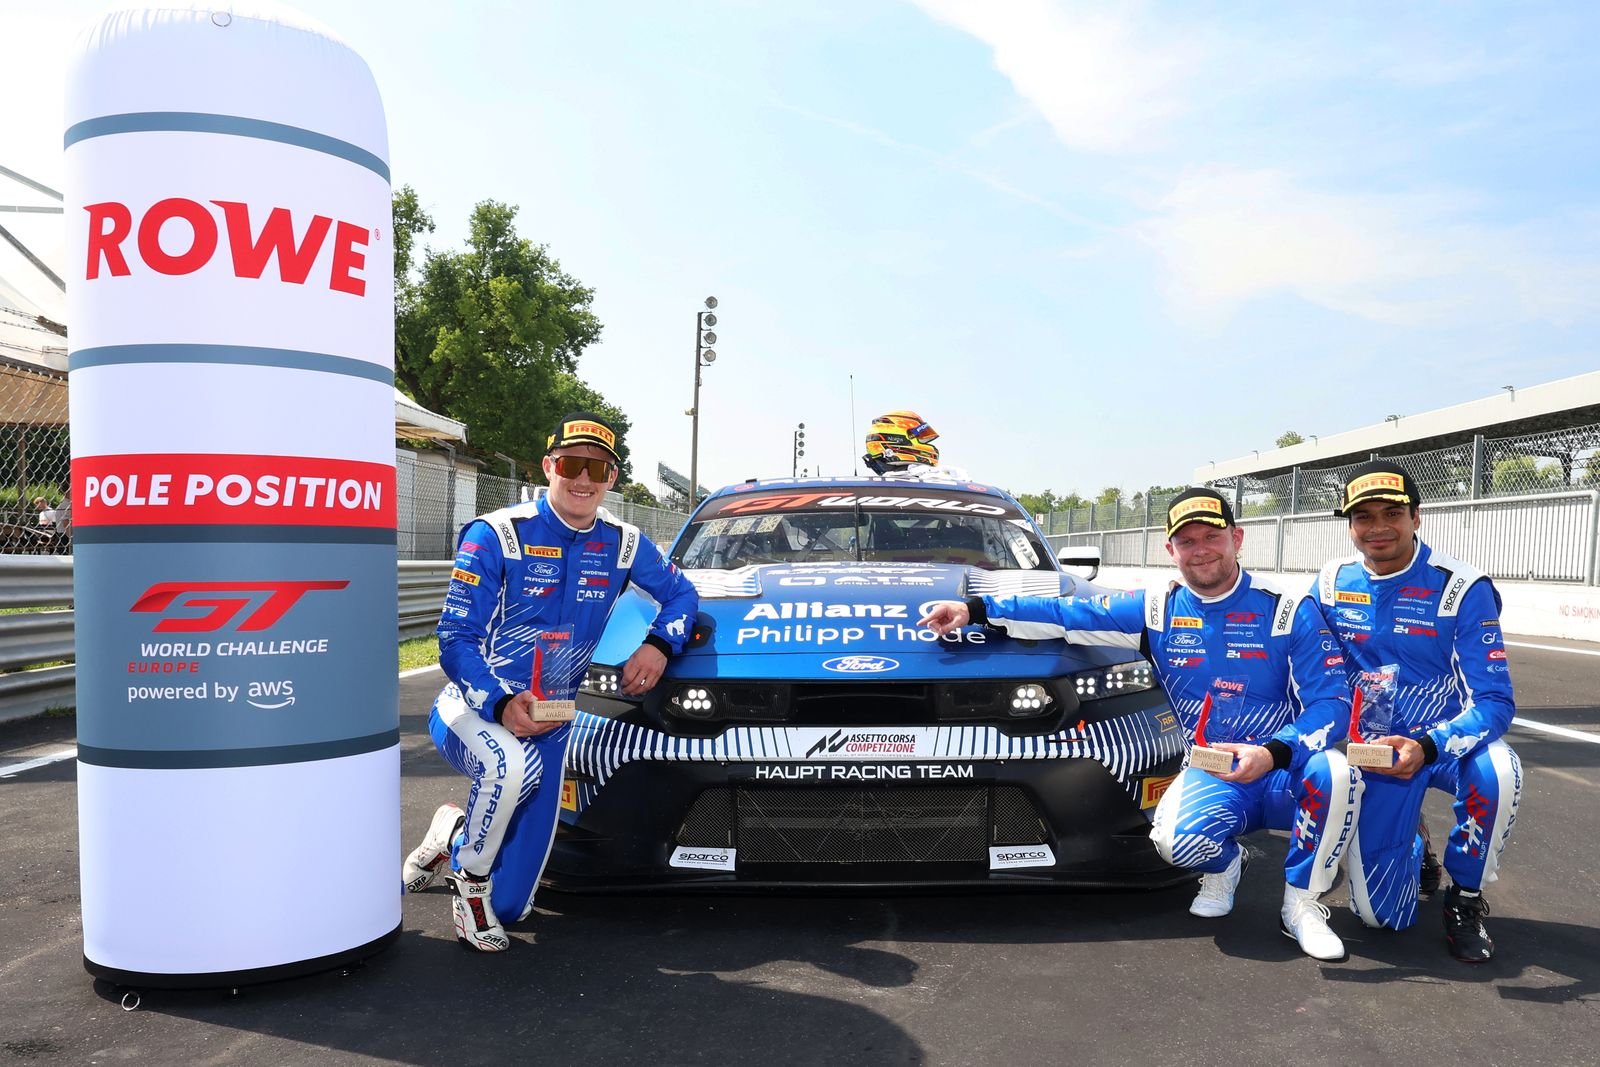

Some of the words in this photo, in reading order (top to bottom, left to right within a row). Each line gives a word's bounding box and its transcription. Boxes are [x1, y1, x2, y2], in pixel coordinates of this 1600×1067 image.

[83, 197, 370, 297] ROWE
[84, 473, 172, 507] POLE
[184, 474, 382, 510] POSITION
[816, 496, 1006, 516] WORLD
[528, 546, 559, 557] PIRELLI
[524, 576, 561, 584] RACING
[1338, 592, 1368, 603] PIRELLI
[1444, 577, 1466, 612] sparco
[743, 601, 908, 621] Allianz
[1277, 598, 1294, 631] sparco
[1336, 621, 1372, 631] RACING
[1395, 617, 1435, 627] CROWDSTRIKE
[541, 632, 571, 640] ROWE
[737, 625, 865, 645] Philipp
[1174, 633, 1197, 645] Ford
[140, 642, 211, 658] WORLD
[216, 638, 329, 657] CHALLENGE
[127, 661, 201, 673] EUROPE
[836, 656, 884, 671] Ford
[127, 682, 208, 702] powered
[215, 682, 239, 702] by
[248, 680, 294, 697] aws
[1213, 679, 1245, 692] ROWE
[850, 733, 888, 743] ASSETTO
[888, 734, 916, 743] CORSA
[477, 730, 507, 780] FORD
[845, 743, 915, 753] COMPETIZIONE
[1358, 758, 1381, 766] AWARD
[756, 766, 827, 779] HAUPT
[831, 765, 911, 778] RACING
[916, 764, 974, 777] TEAM
[474, 783, 503, 856] RACING
[1325, 810, 1354, 869] FORD
[679, 853, 729, 862] sparco
[996, 851, 1047, 862] sparco
[407, 876, 427, 892] OMP
[469, 886, 487, 894] OMP
[482, 934, 507, 948] OMP
